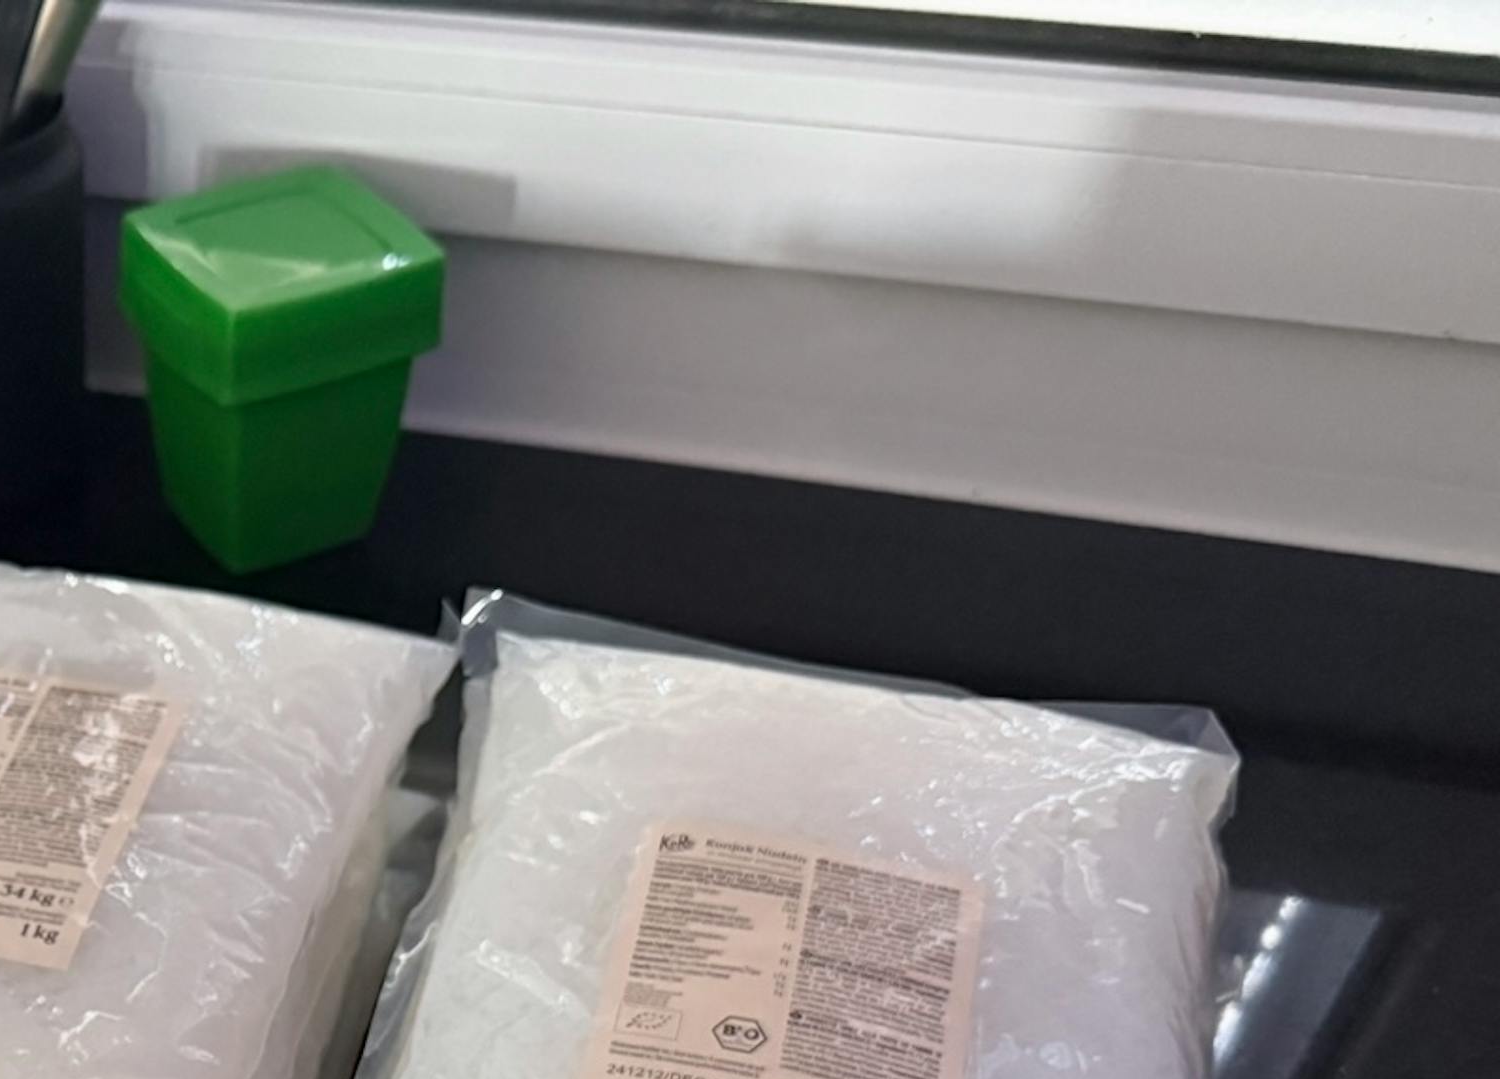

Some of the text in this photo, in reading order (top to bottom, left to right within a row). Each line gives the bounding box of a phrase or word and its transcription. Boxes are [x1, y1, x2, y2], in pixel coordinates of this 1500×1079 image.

[29, 888, 56, 908] kg
[20, 922, 60, 946] 1 kg
